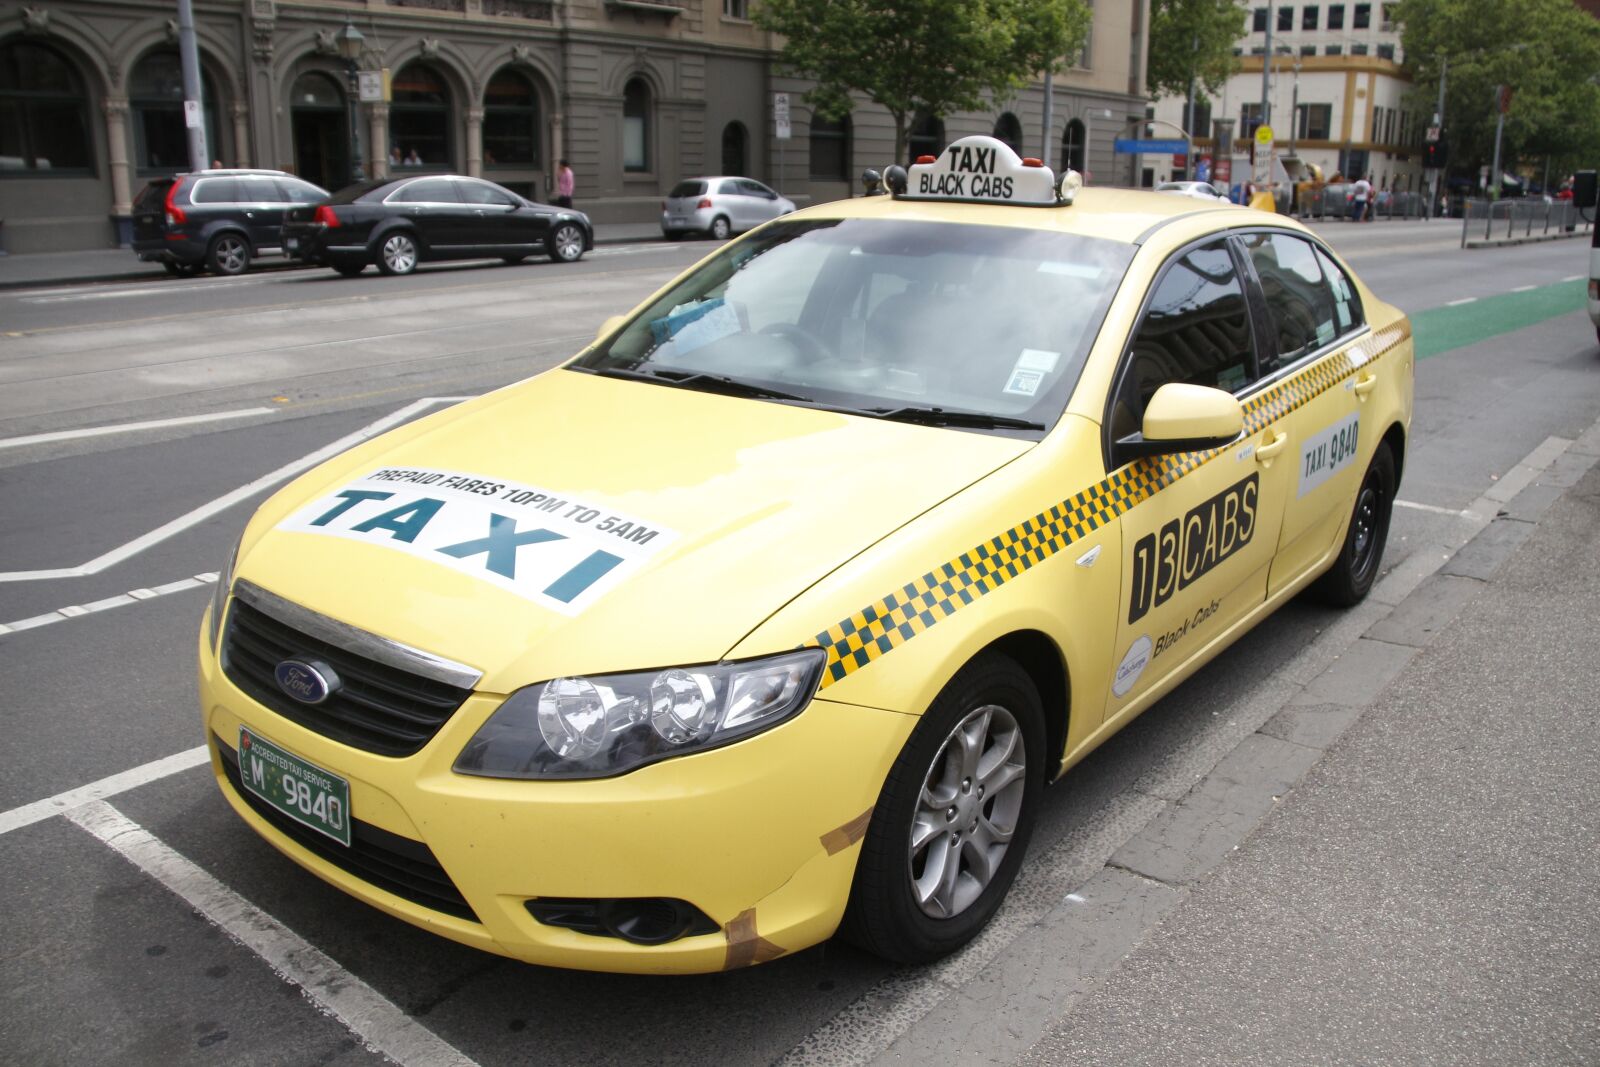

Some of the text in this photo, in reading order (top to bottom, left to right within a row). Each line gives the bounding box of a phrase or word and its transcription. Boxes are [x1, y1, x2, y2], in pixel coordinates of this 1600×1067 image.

[919, 173, 1014, 198] BLACK CABS
[948, 146, 996, 173] TAXI
[1305, 420, 1359, 478] TAXI 9840
[367, 469, 660, 546] PREPAID FARES 10PM TO 5AM
[308, 489, 626, 605] TAXI
[1152, 597, 1222, 659] Black Cabs
[283, 667, 316, 696] Ford
[251, 742, 333, 793] ACCREDITED TAXI SERVICE
[282, 773, 343, 831] 9840
